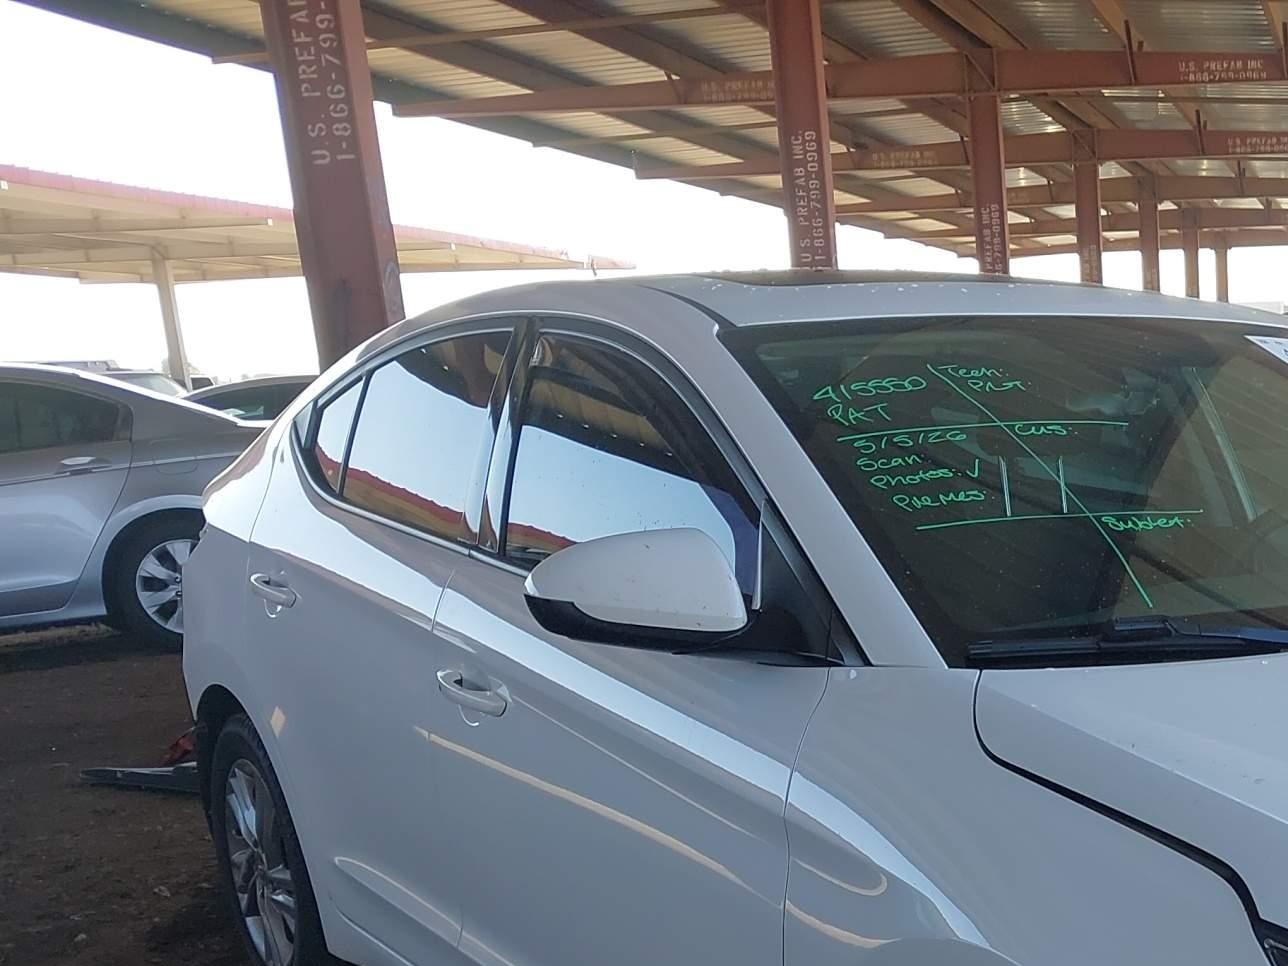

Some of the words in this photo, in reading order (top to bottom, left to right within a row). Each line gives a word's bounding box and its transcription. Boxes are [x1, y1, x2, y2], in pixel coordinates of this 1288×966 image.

[308, 114, 331, 165] U.S.
[791, 130, 804, 159] INC.
[794, 167, 809, 226] PREFAB
[804, 130, 827, 261] 1-866-799-0969
[827, 403, 891, 426] PAT
